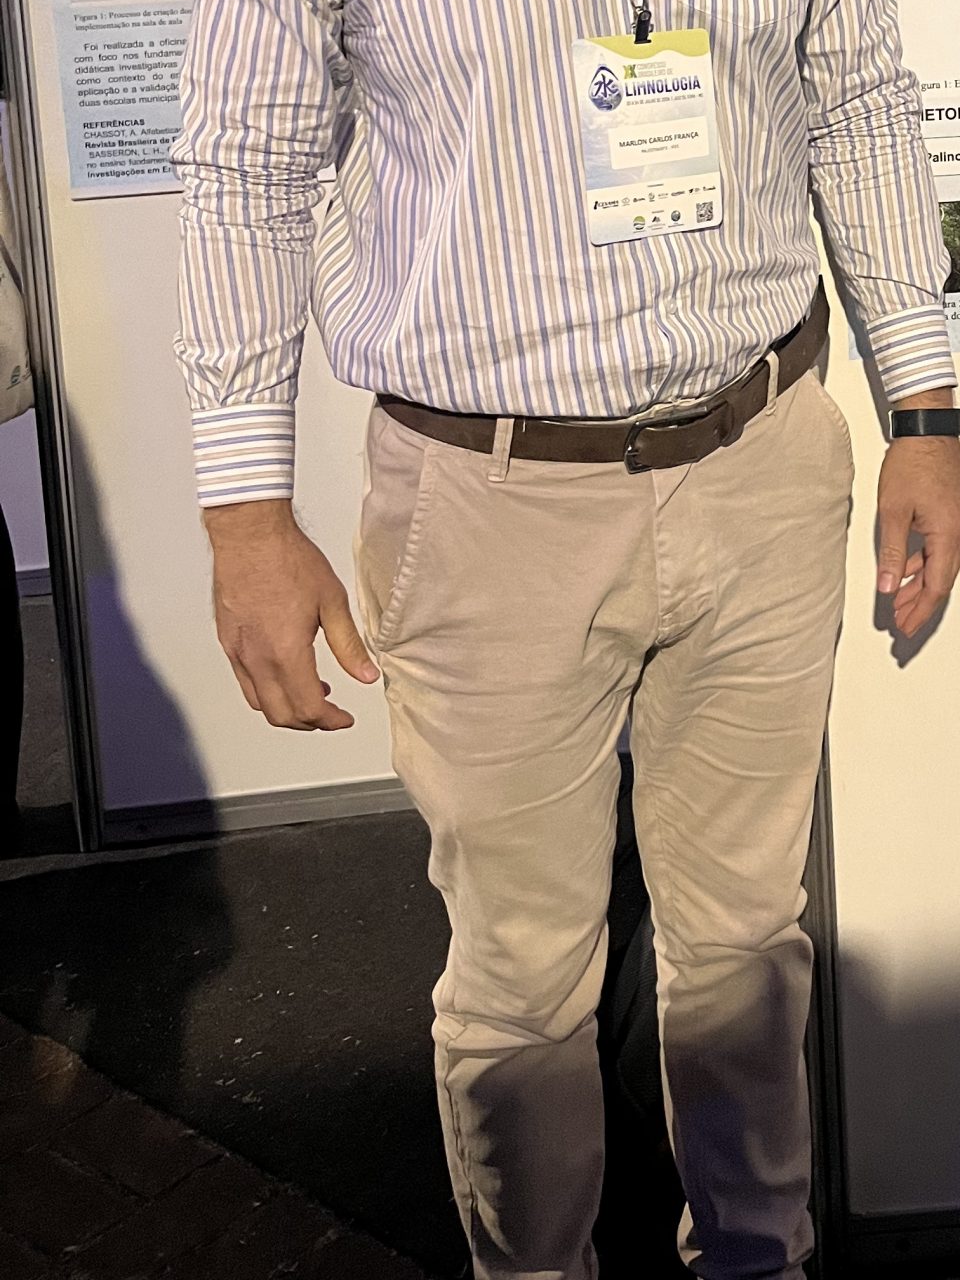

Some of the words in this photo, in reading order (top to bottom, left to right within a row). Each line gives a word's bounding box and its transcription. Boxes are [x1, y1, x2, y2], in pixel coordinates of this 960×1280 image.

[625, 75, 701, 97] LIMNOLOGIA
[619, 137, 647, 148] MARLON
[649, 135, 673, 145] CARLOS
[674, 131, 699, 141] FRANÇA
